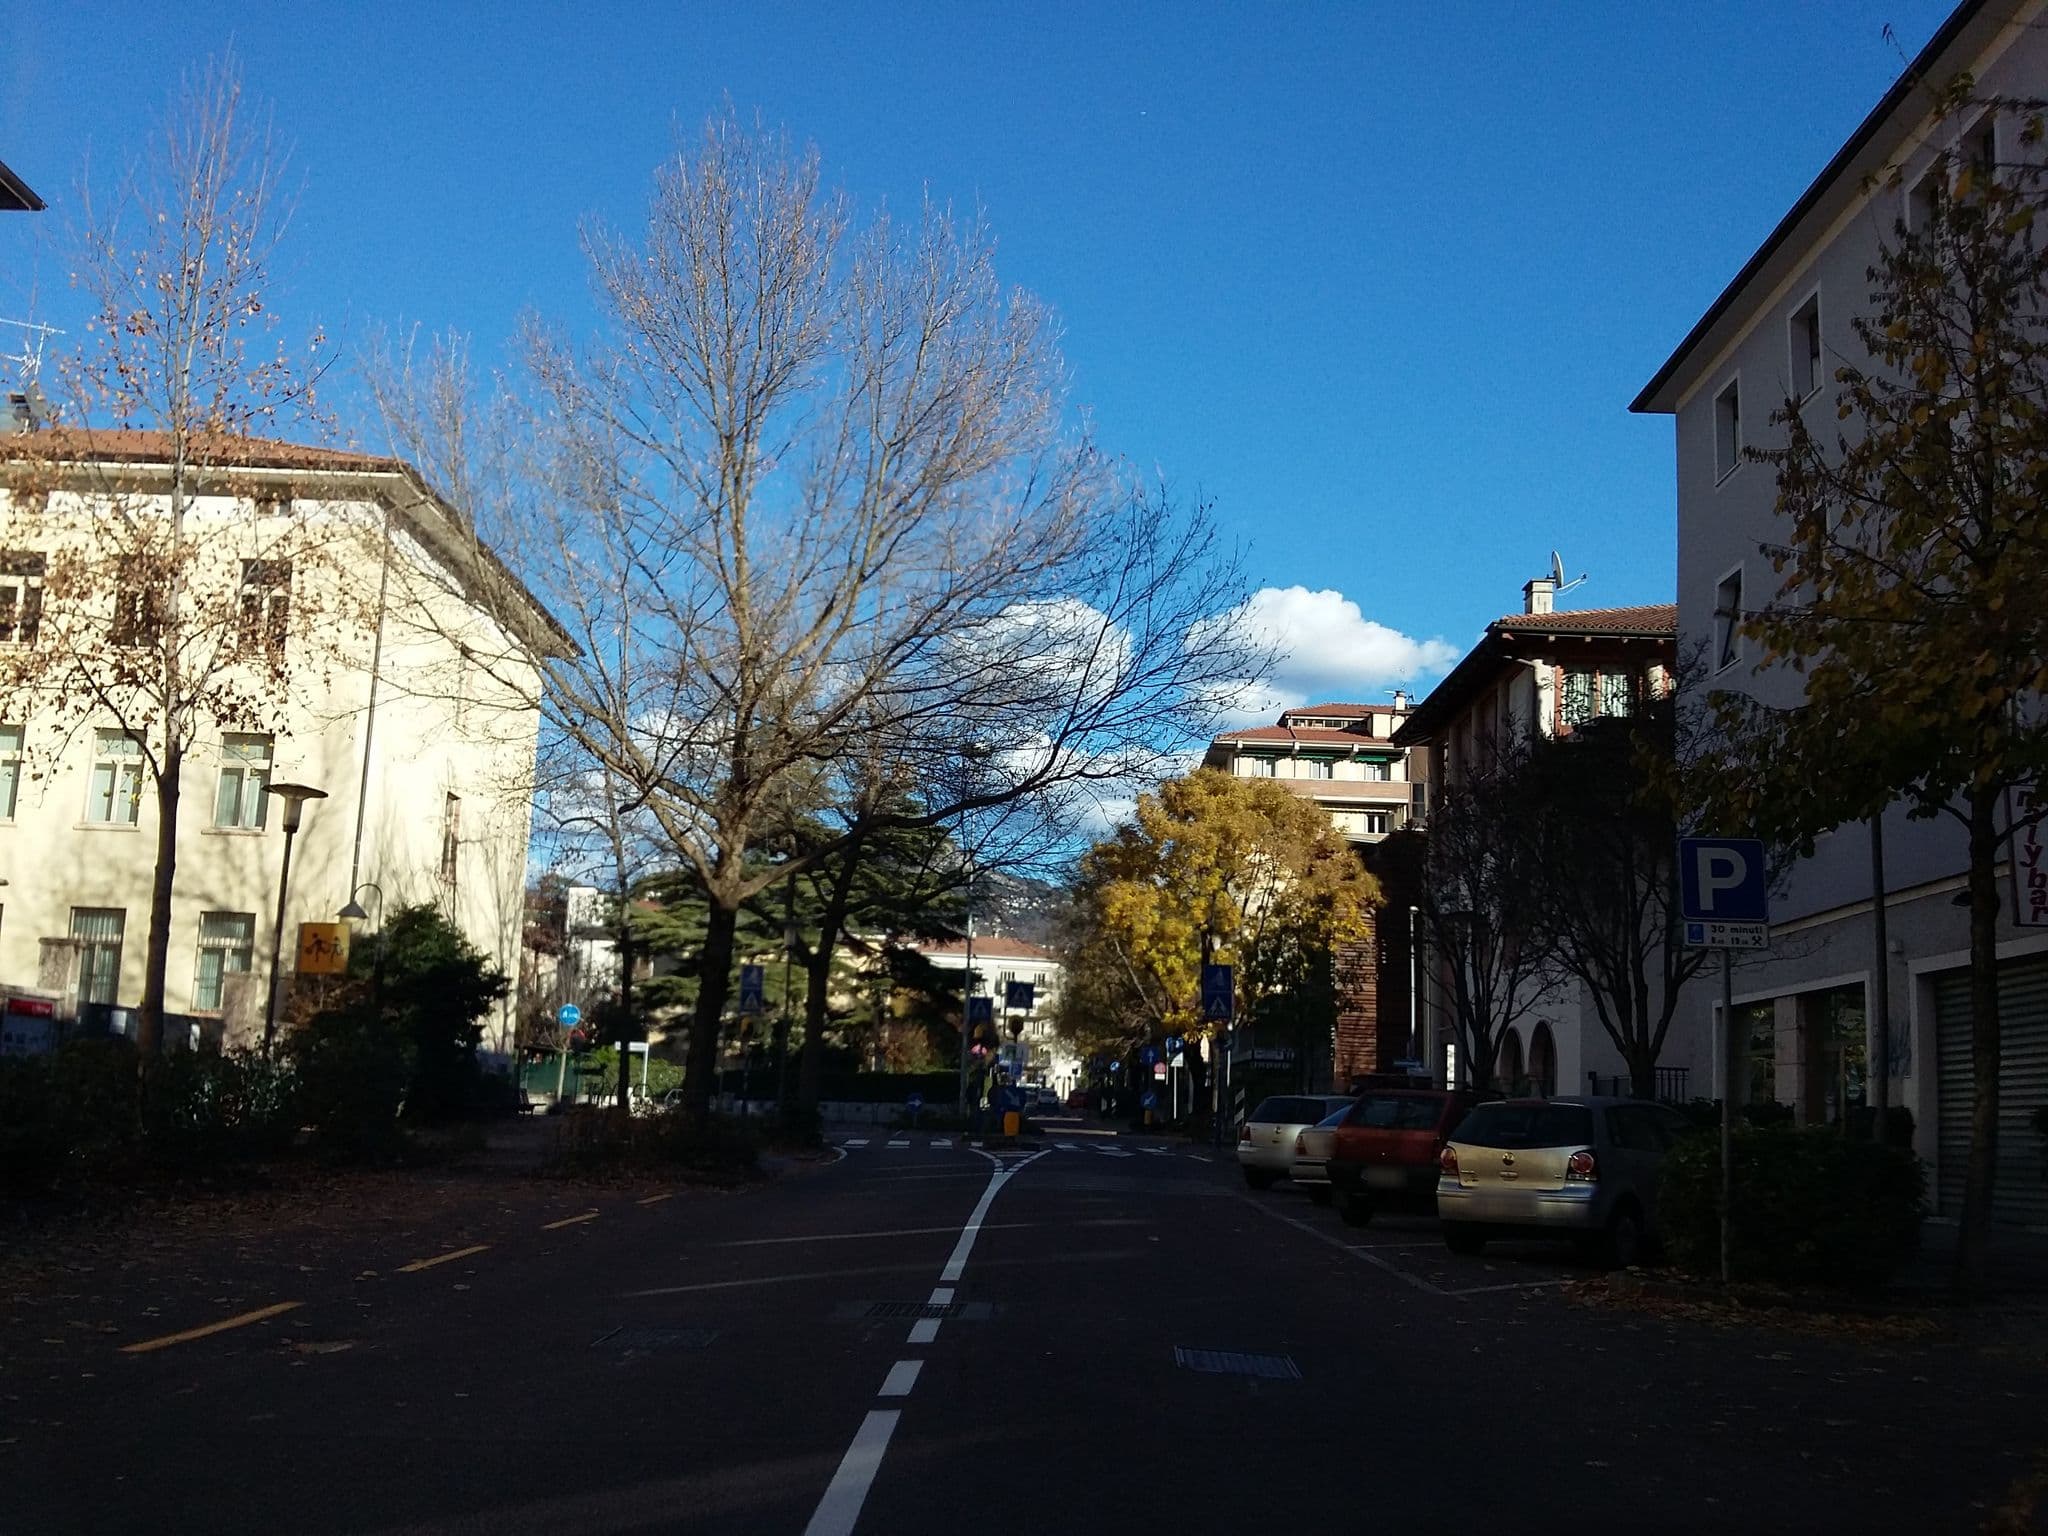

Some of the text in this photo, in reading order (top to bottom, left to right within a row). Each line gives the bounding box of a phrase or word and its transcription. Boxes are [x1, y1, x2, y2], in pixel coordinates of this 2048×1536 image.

[1697, 847, 1747, 910] P
[1711, 925, 1763, 935] 30 minuti
